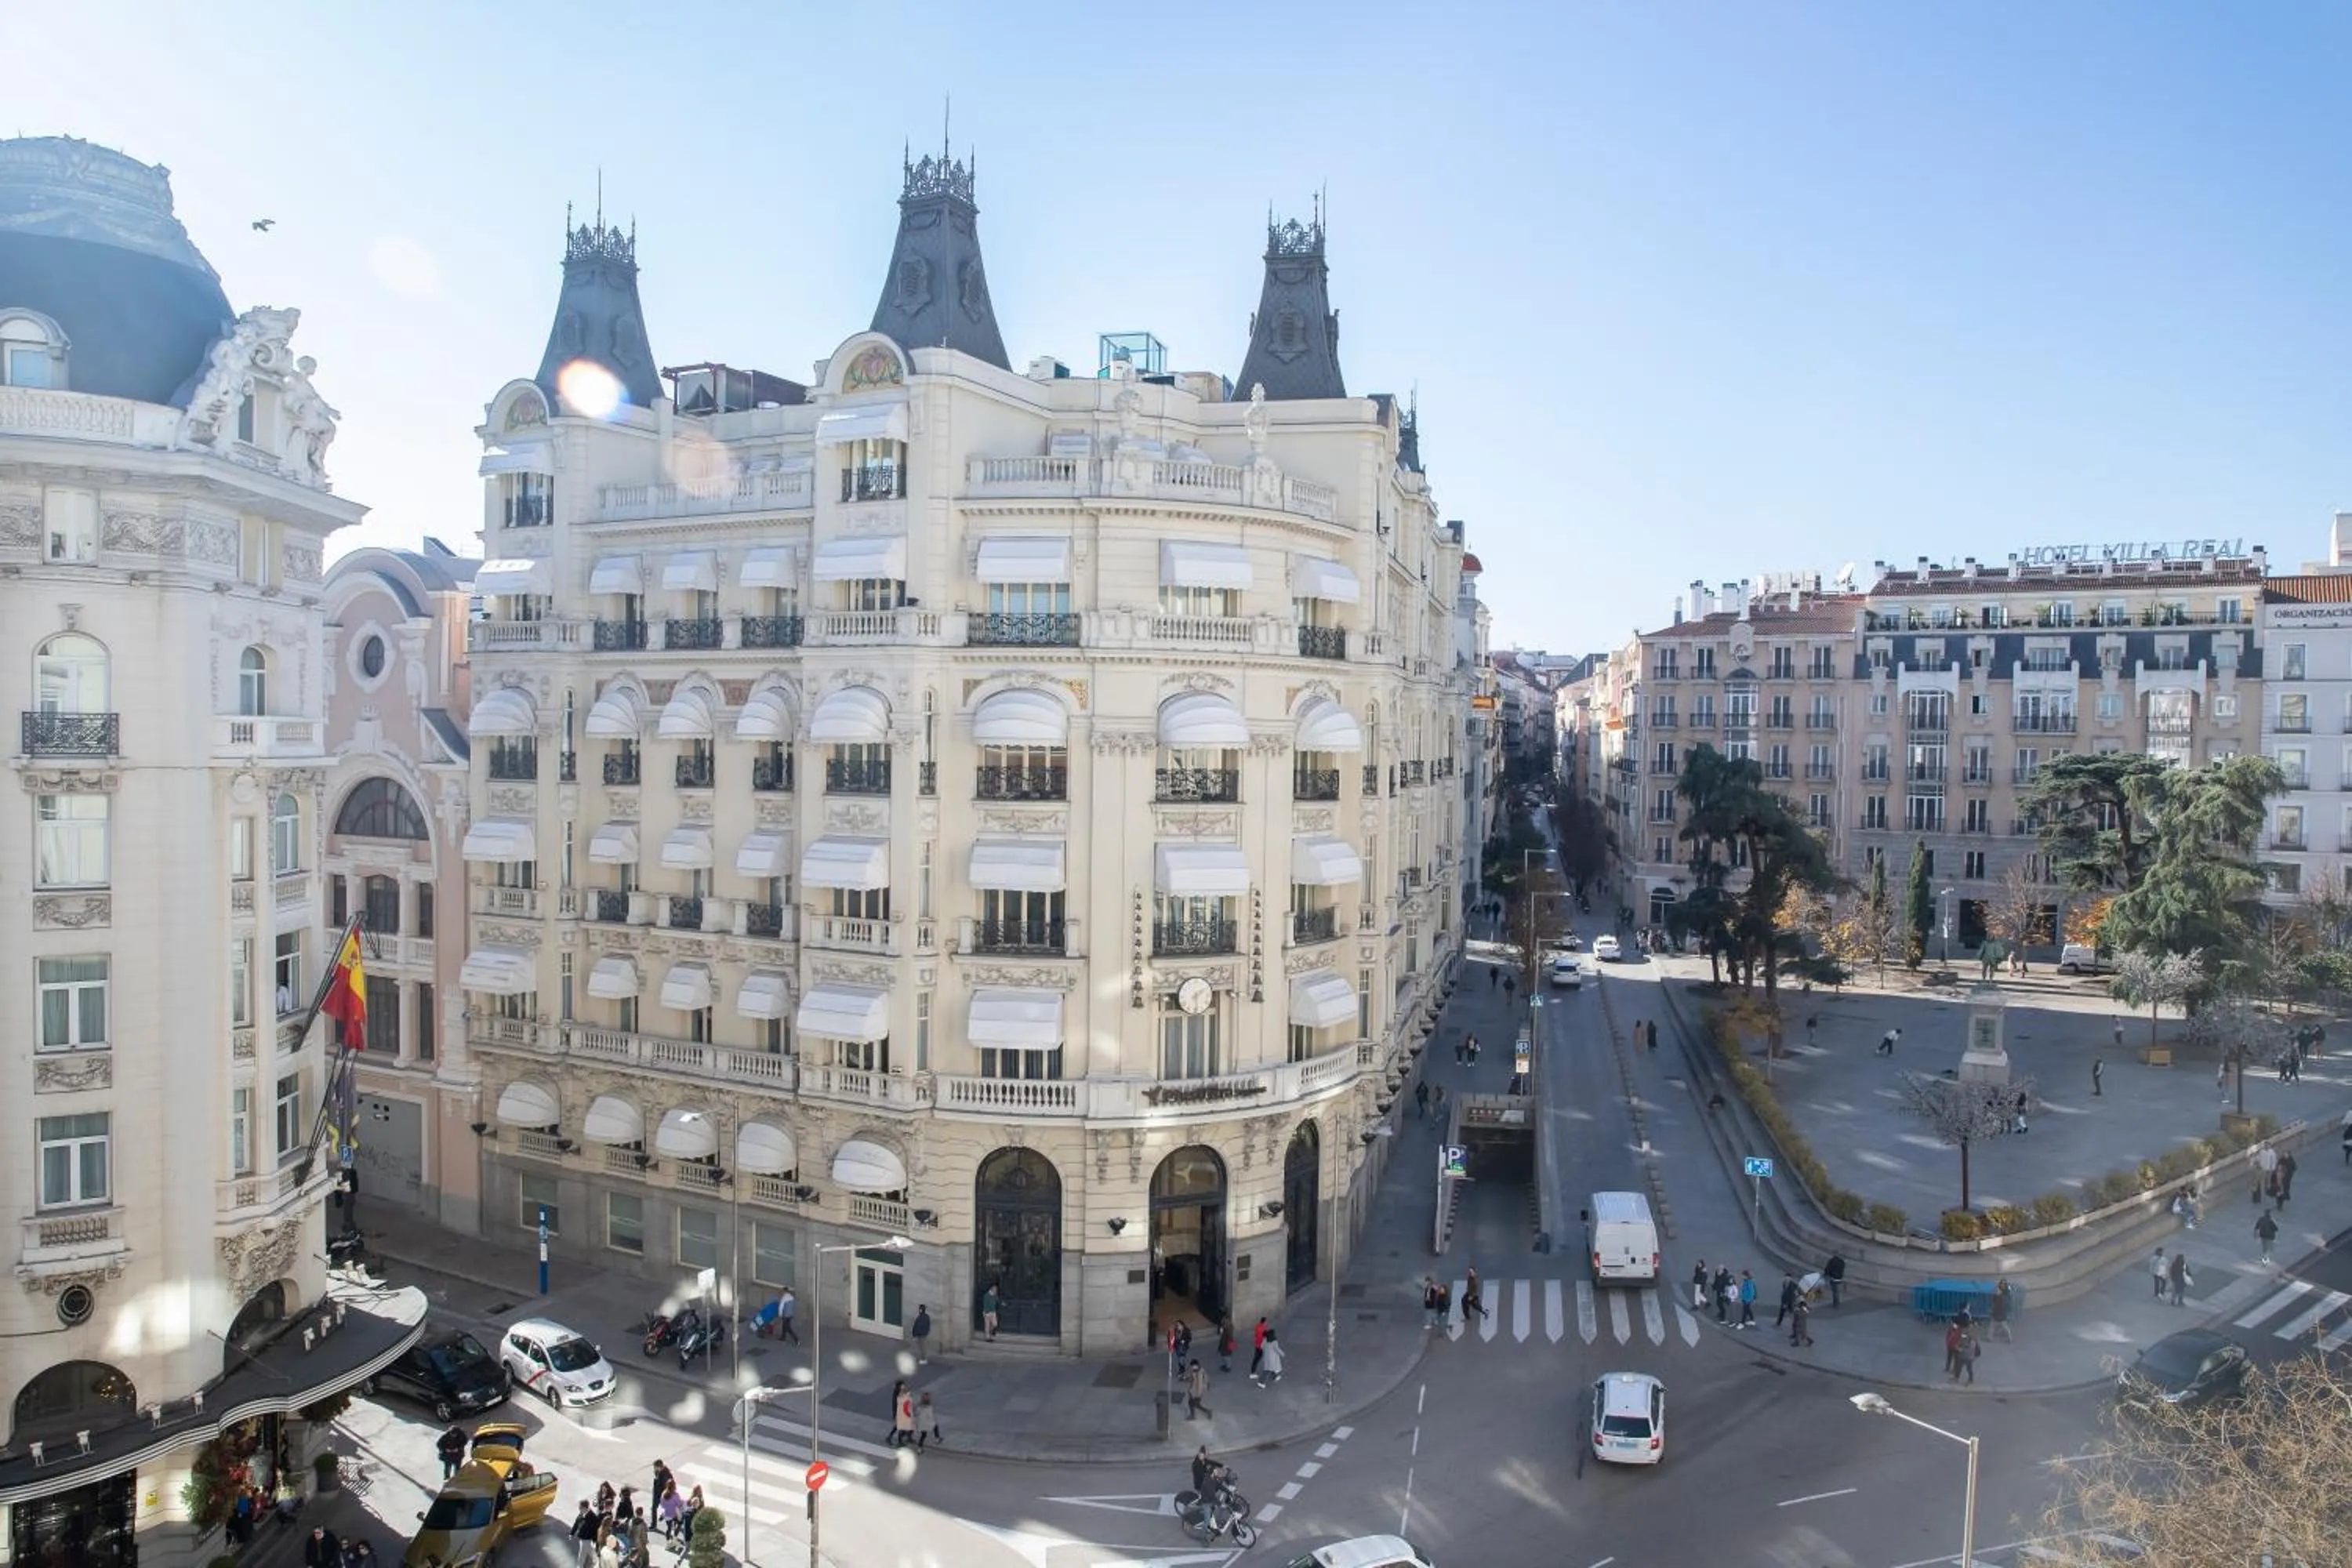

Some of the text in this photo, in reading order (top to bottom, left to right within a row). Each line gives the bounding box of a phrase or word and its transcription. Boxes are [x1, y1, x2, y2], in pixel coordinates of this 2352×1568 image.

[2024, 538, 2248, 564] HOTEL VILLA REAL
[1448, 1147, 1461, 1165] P
